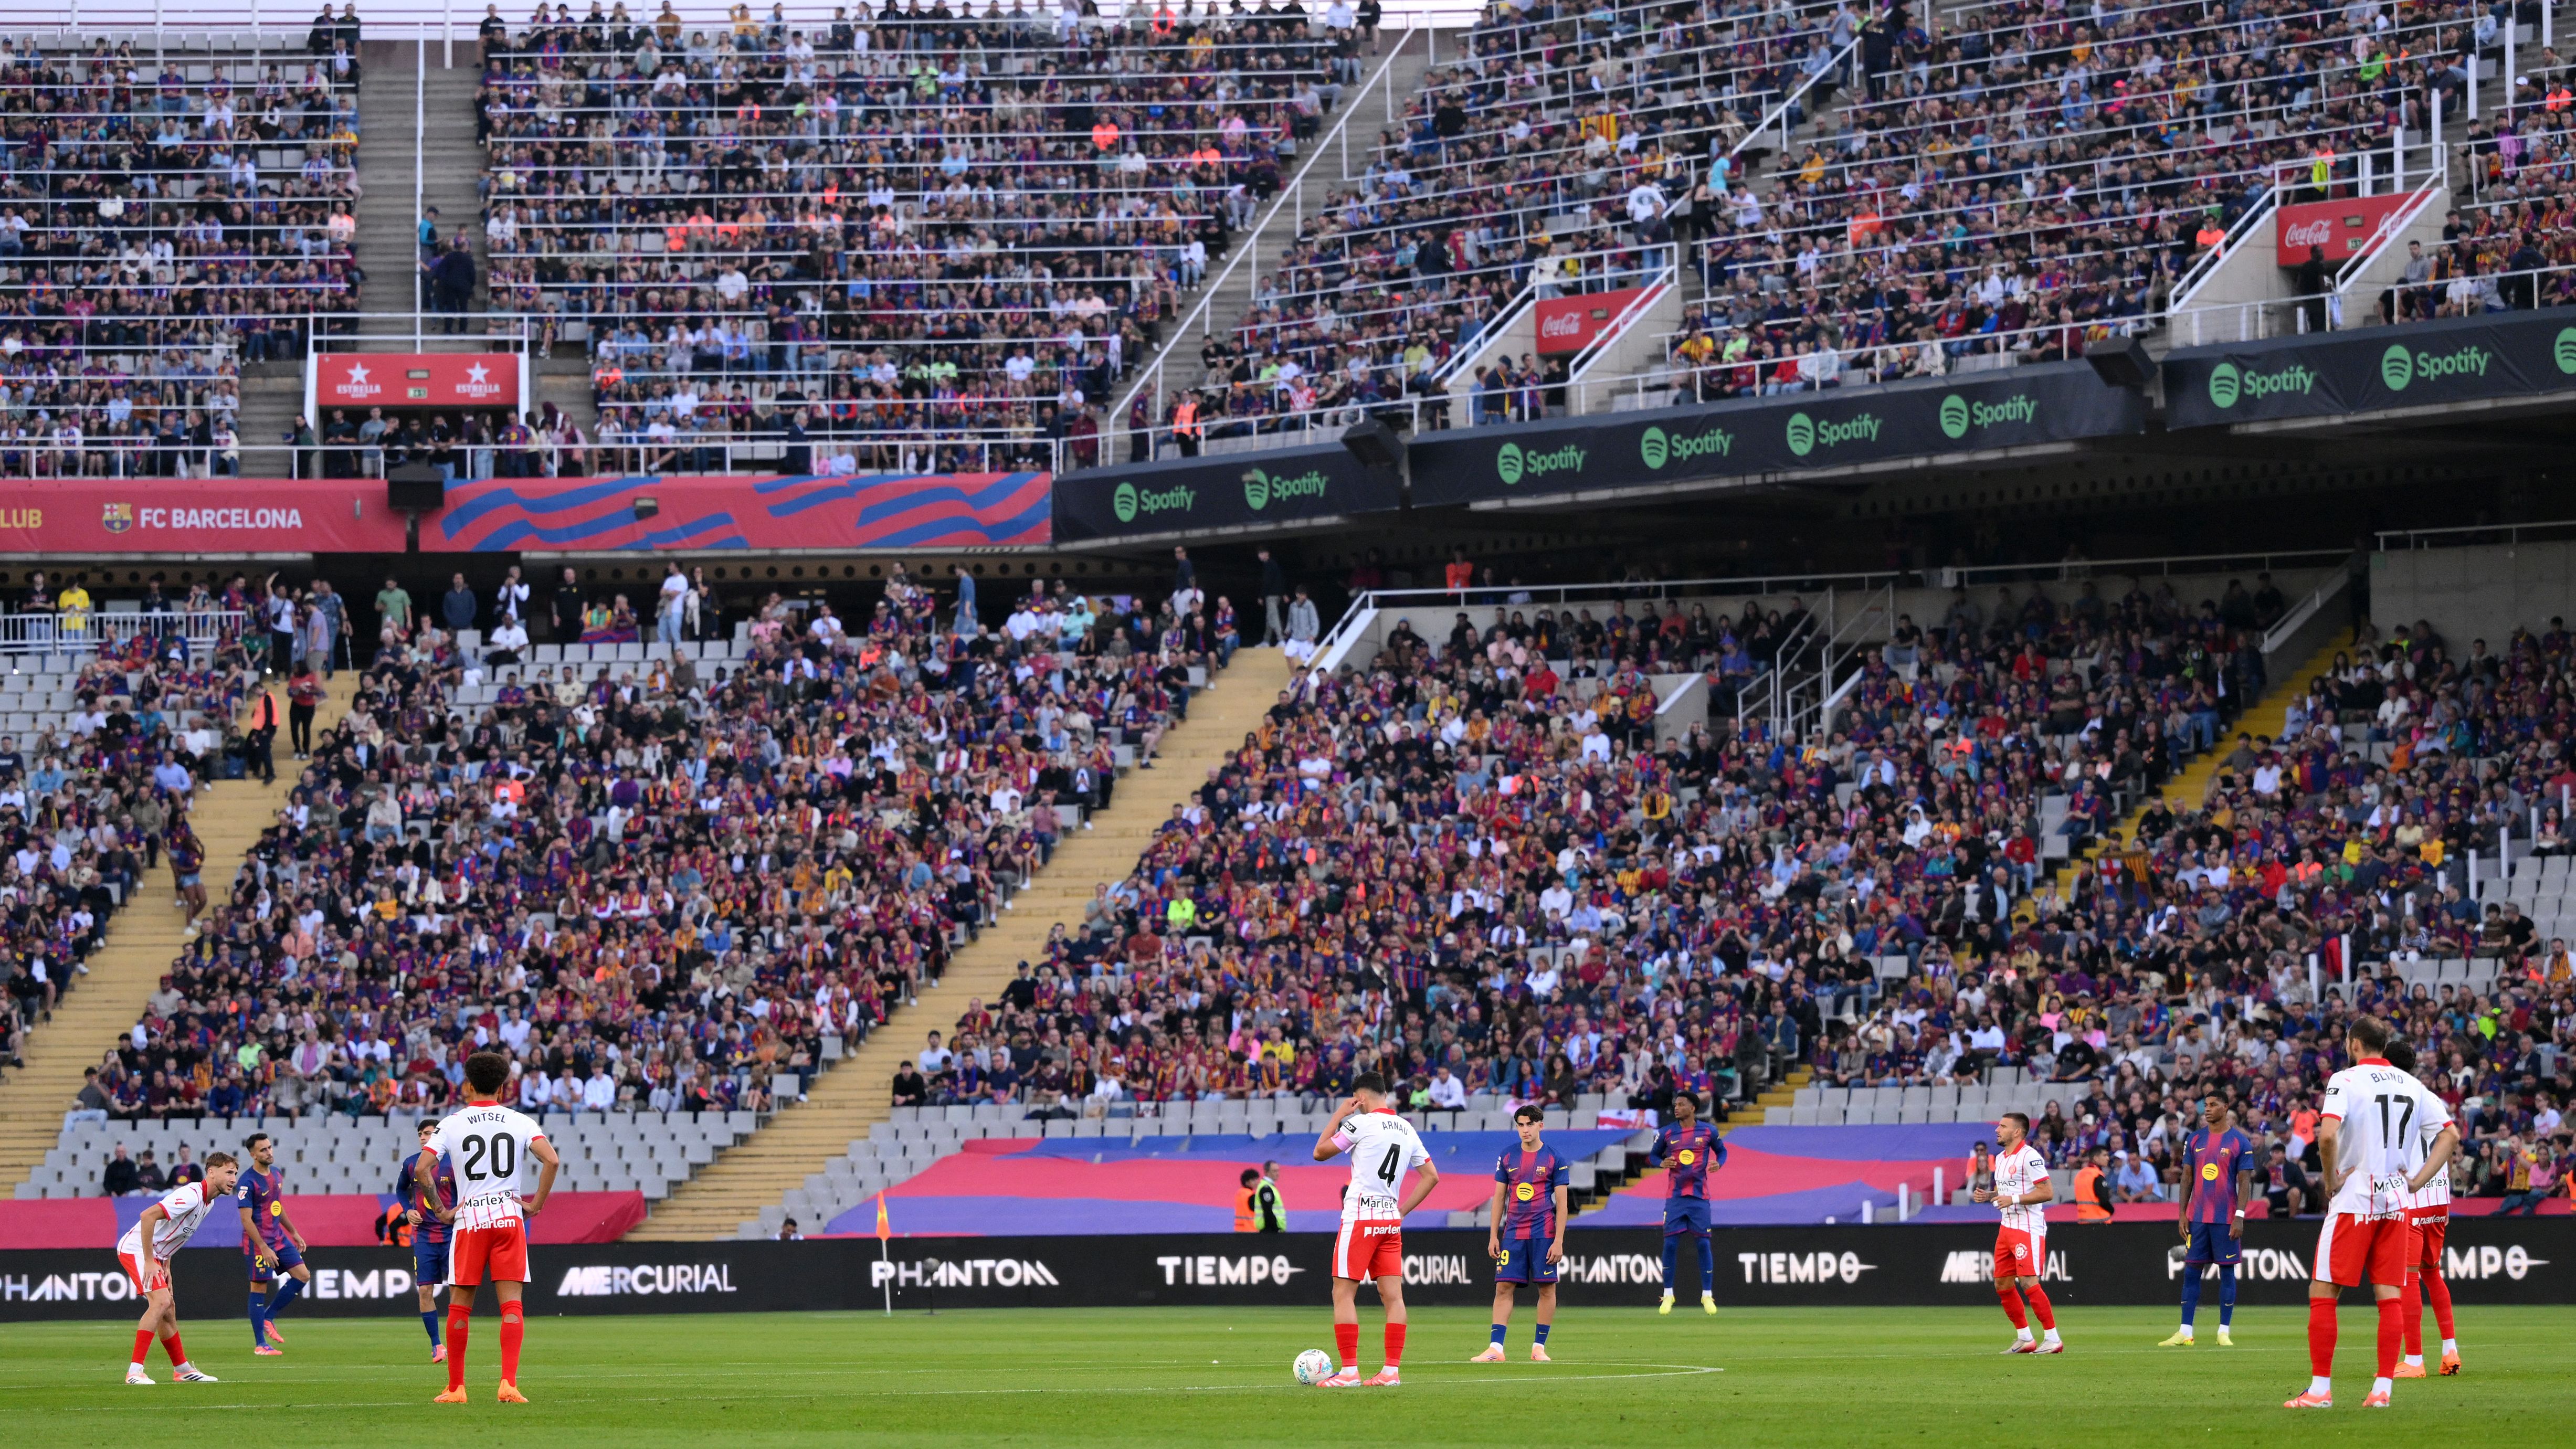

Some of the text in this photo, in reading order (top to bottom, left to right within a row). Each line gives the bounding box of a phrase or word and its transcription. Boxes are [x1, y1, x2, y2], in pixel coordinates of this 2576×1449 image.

[2417, 346, 2488, 380] Spotify
[336, 384, 382, 394] ESTRELLA
[456, 384, 500, 393] ESTRELLA
[2244, 365, 2315, 399] Spotify
[1972, 394, 2036, 429] Spotify
[1671, 428, 1731, 461] Spotify
[1818, 413, 1881, 447] Spotify
[1526, 445, 1584, 476] Spotify
[1140, 485, 1195, 514] Spotify
[1272, 471, 1326, 501] Spotify
[140, 508, 302, 528] FC BARCELONA
[2370, 1072, 2404, 1084] BLIND
[467, 1112, 505, 1124] WITSEL
[1382, 1121, 1408, 1135] ARNAU
[2374, 1094, 2414, 1149] 17
[462, 1132, 515, 1181] 20
[1377, 1143, 1401, 1188] 4
[2374, 1177, 2405, 1193] Mrlex
[464, 1196, 504, 1209] Marlex
[1360, 1197, 1395, 1209] Marlex
[473, 1219, 516, 1232] parlem
[871, 1258, 1059, 1287] PHANTOM
[1156, 1254, 1306, 1285] TIEMPO
[1496, 1249, 1510, 1266] 9
[1738, 1251, 1878, 1284] TIEMPO
[0, 1272, 147, 1302] HANTO
[557, 1264, 737, 1296] MERCURIAL
